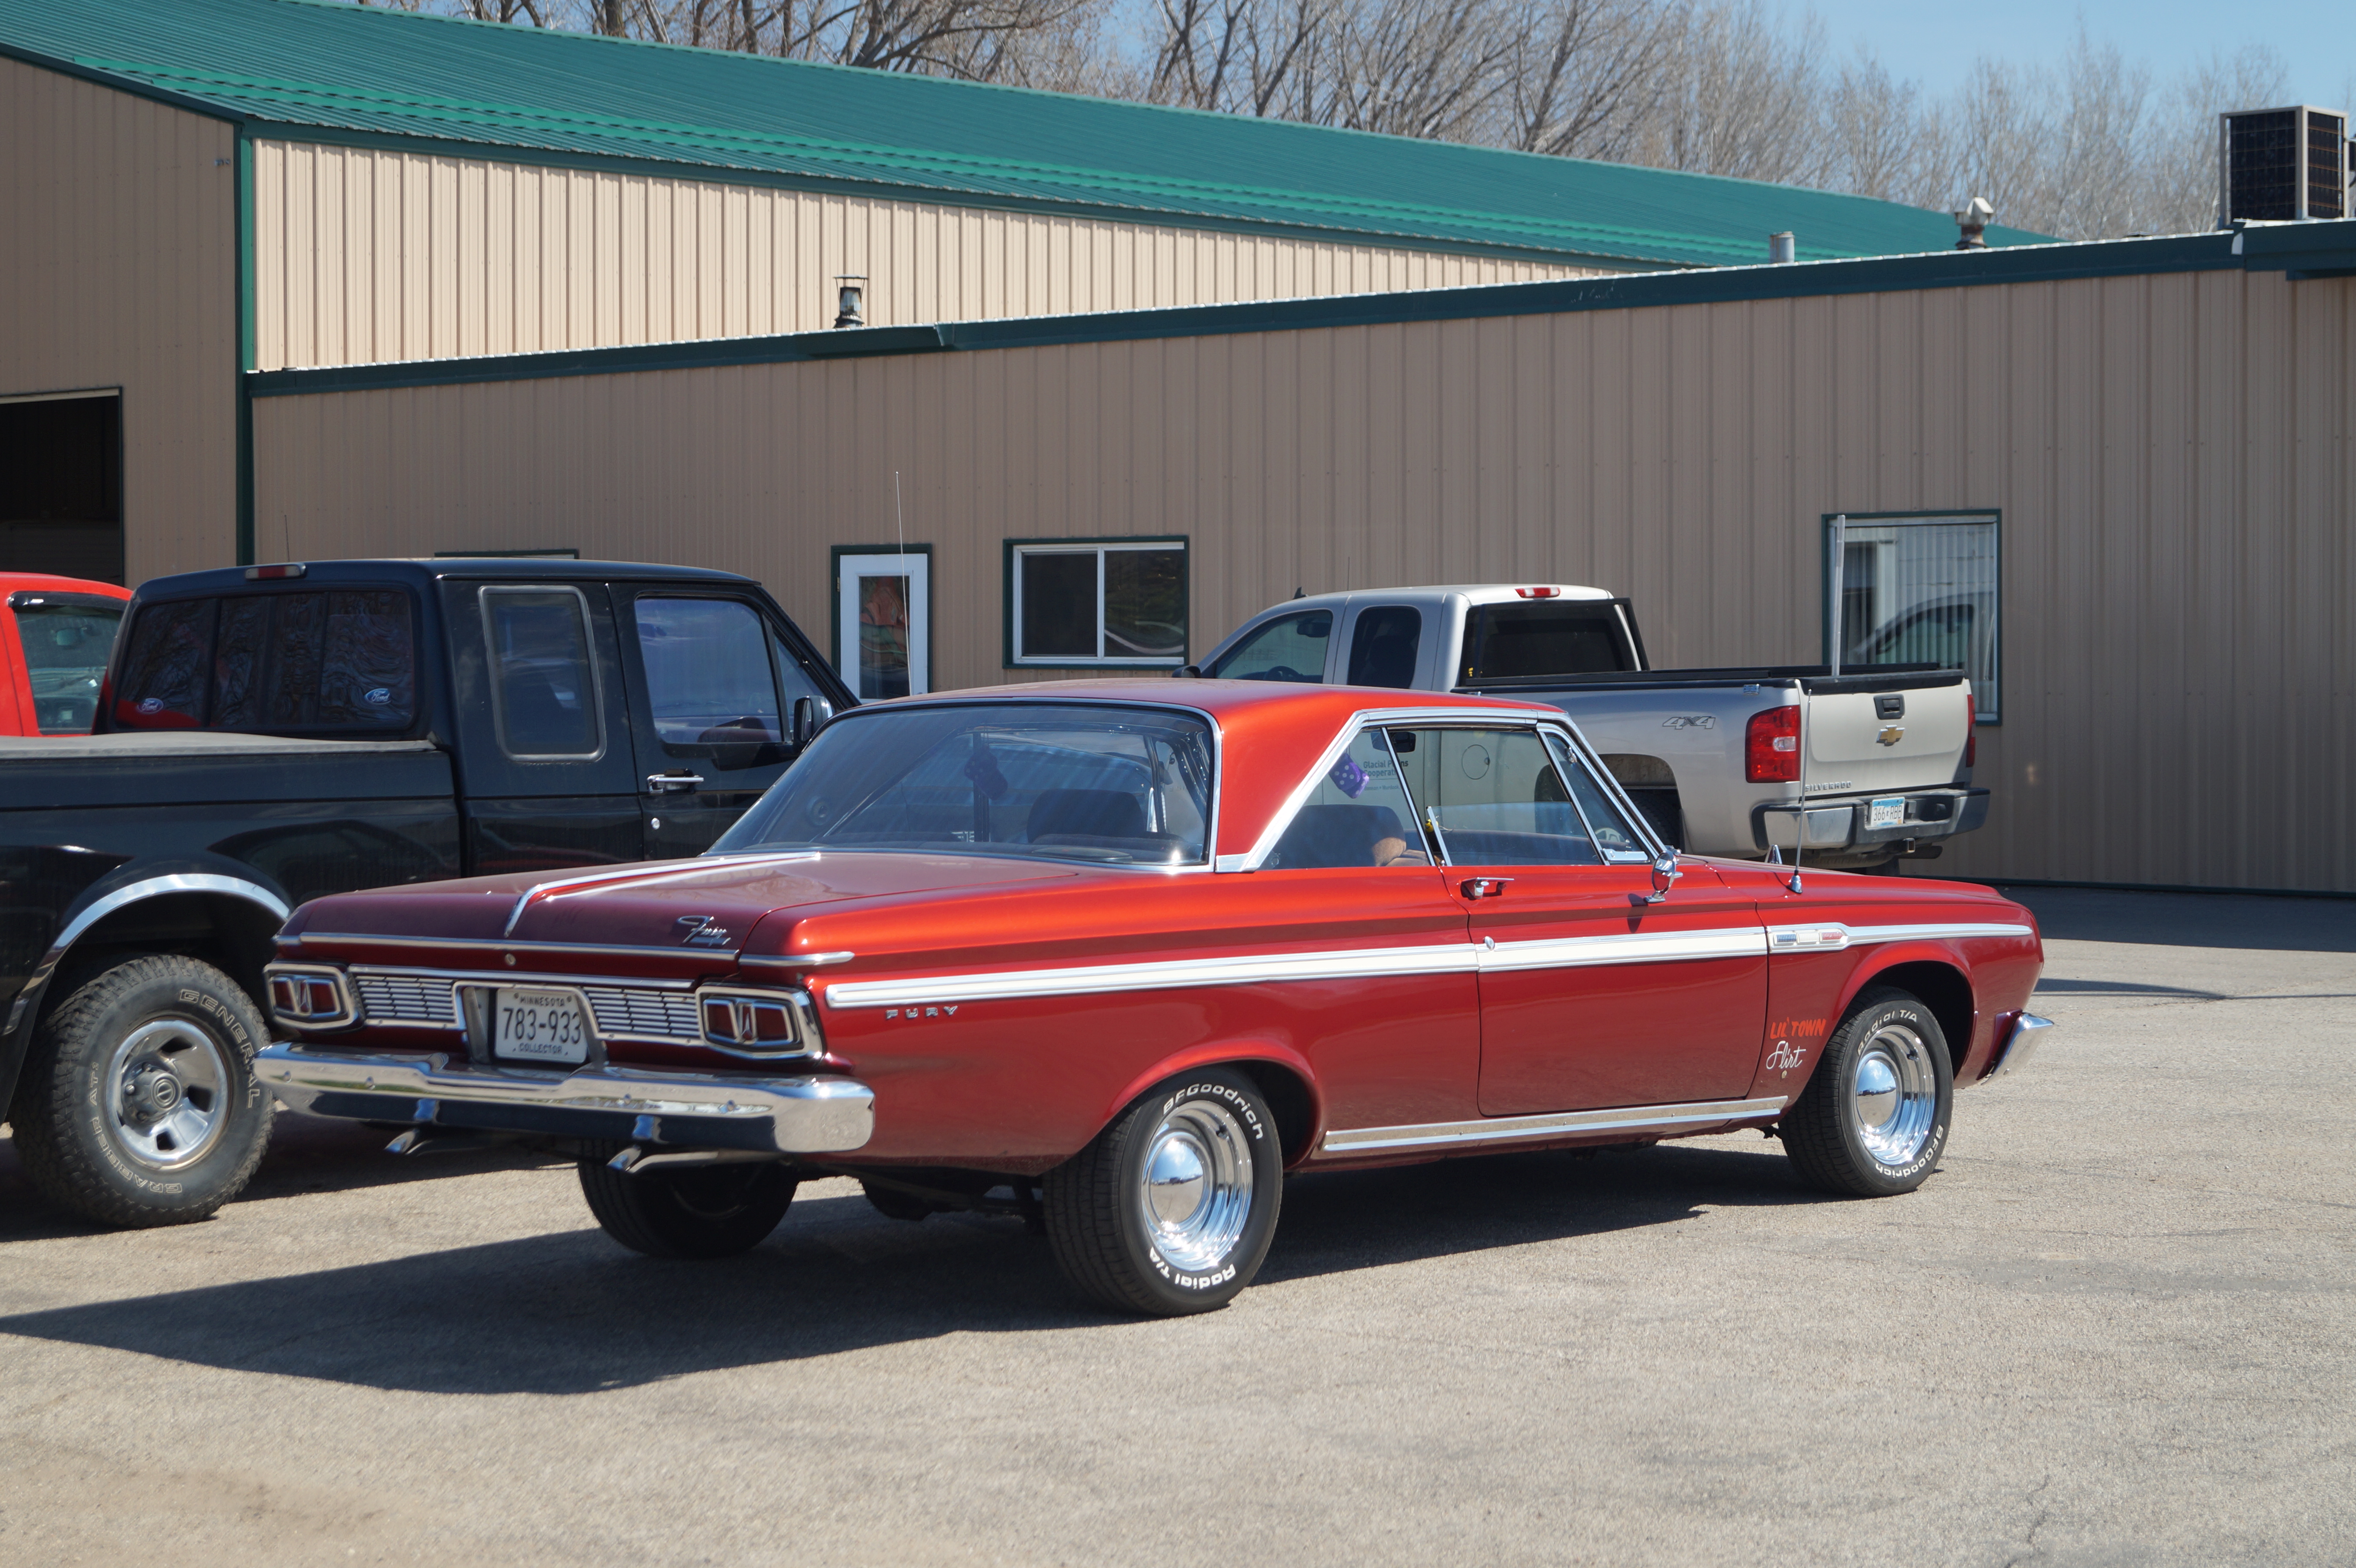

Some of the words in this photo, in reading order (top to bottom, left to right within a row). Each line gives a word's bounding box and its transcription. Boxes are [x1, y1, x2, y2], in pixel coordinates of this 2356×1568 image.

[142, 700, 159, 711] Ford
[372, 690, 390, 702] Ford
[1363, 760, 1386, 768] Glacial
[1805, 781, 1852, 792] SILVERADO
[1874, 806, 1886, 821] 366
[676, 915, 731, 947] Fury
[520, 996, 565, 1007] MINNESOTA
[886, 1005, 958, 1019] FURY
[503, 1007, 582, 1044] 783-933
[1792, 1018, 1827, 1037] TOWN
[1857, 1011, 1895, 1056] Radial
[1900, 1009, 1917, 1023] T/A
[519, 1043, 563, 1054] COLLECTOR
[1766, 1040, 1806, 1069] Flirt
[1163, 1083, 1263, 1140] BFGoodrich
[90, 1116, 183, 1194] GRABBER
[1875, 1124, 1944, 1179] BFGoodrich
[1150, 1246, 1170, 1279] T/A
[1175, 1263, 1236, 1290] Radial
